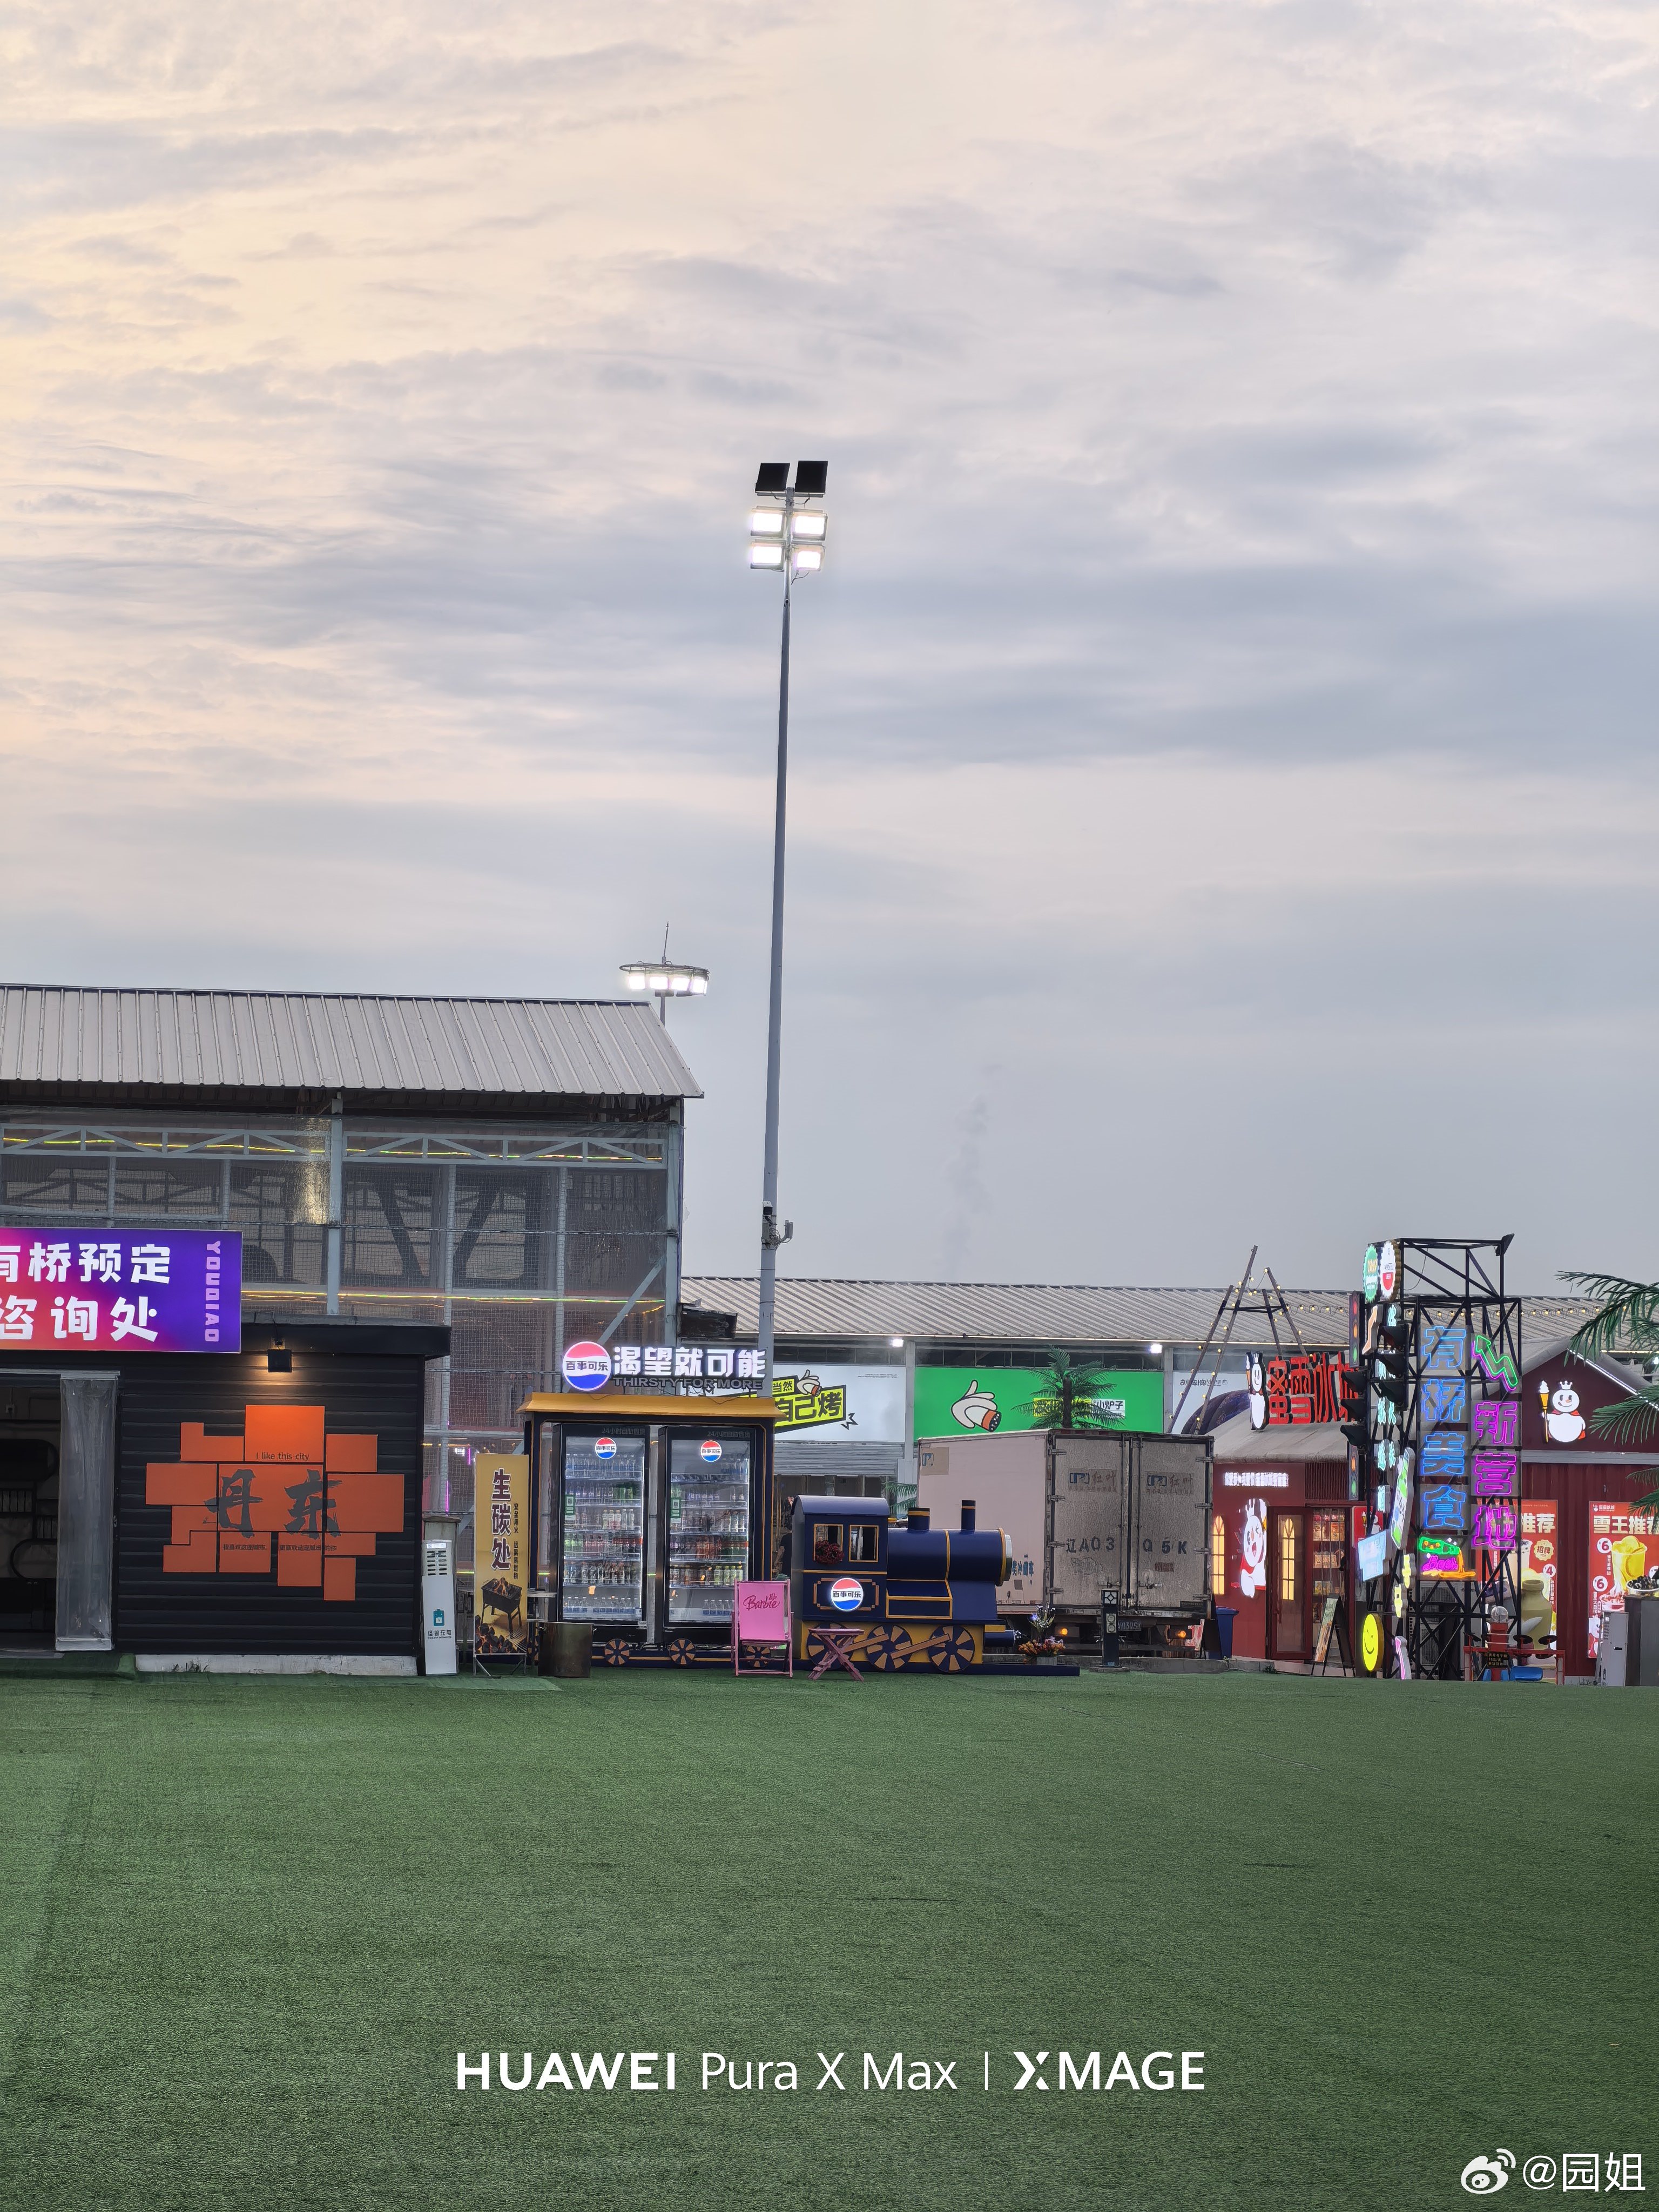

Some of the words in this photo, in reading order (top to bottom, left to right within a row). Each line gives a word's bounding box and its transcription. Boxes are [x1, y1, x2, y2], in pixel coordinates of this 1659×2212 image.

[0, 1294, 159, 1343] 咨询处
[565, 1360, 609, 1372] 百事可乐
[613, 1346, 766, 1378] 渴望就可能
[613, 1377, 680, 1387] THIRSTY
[683, 1378, 715, 1388] FOR
[718, 1379, 763, 1389] MORE
[1421, 1325, 1467, 1529] 有桥美食
[261, 1452, 275, 1460] like
[278, 1452, 292, 1460] this
[295, 1452, 309, 1461] city
[1474, 1400, 1518, 1549] 新营地
[491, 1467, 511, 1570] 生碳处
[1536, 1545, 1551, 1555] 招牌
[743, 1594, 780, 1611] Barbie
